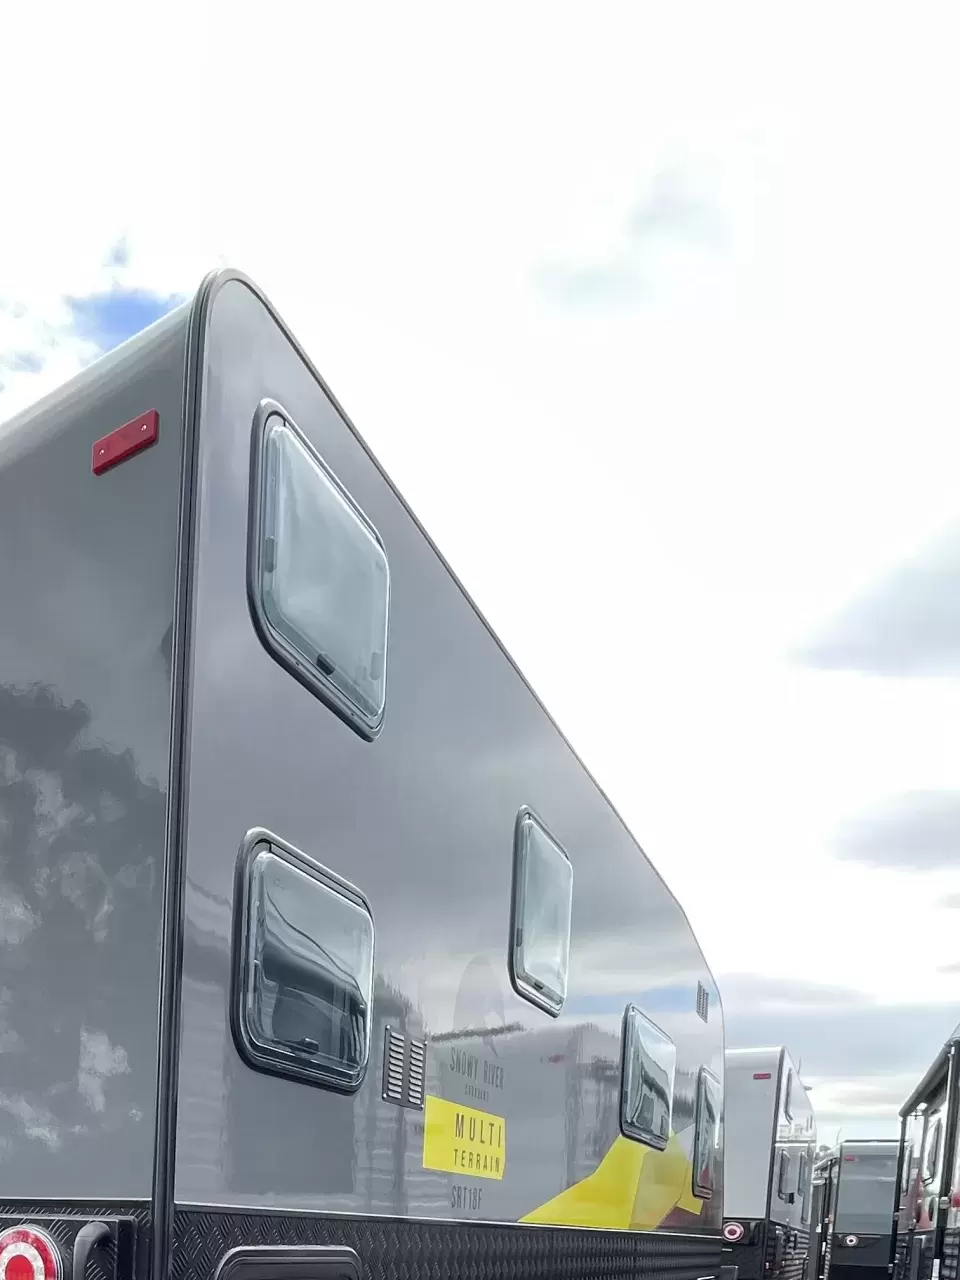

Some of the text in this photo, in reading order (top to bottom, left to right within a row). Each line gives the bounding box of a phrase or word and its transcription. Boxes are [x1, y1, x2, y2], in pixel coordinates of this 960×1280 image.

[450, 1046, 504, 1091] SNOWY RIVER
[455, 1112, 502, 1148] MULTI
[453, 1148, 500, 1173] TERRAIN
[451, 1184, 483, 1211] SRT18F
